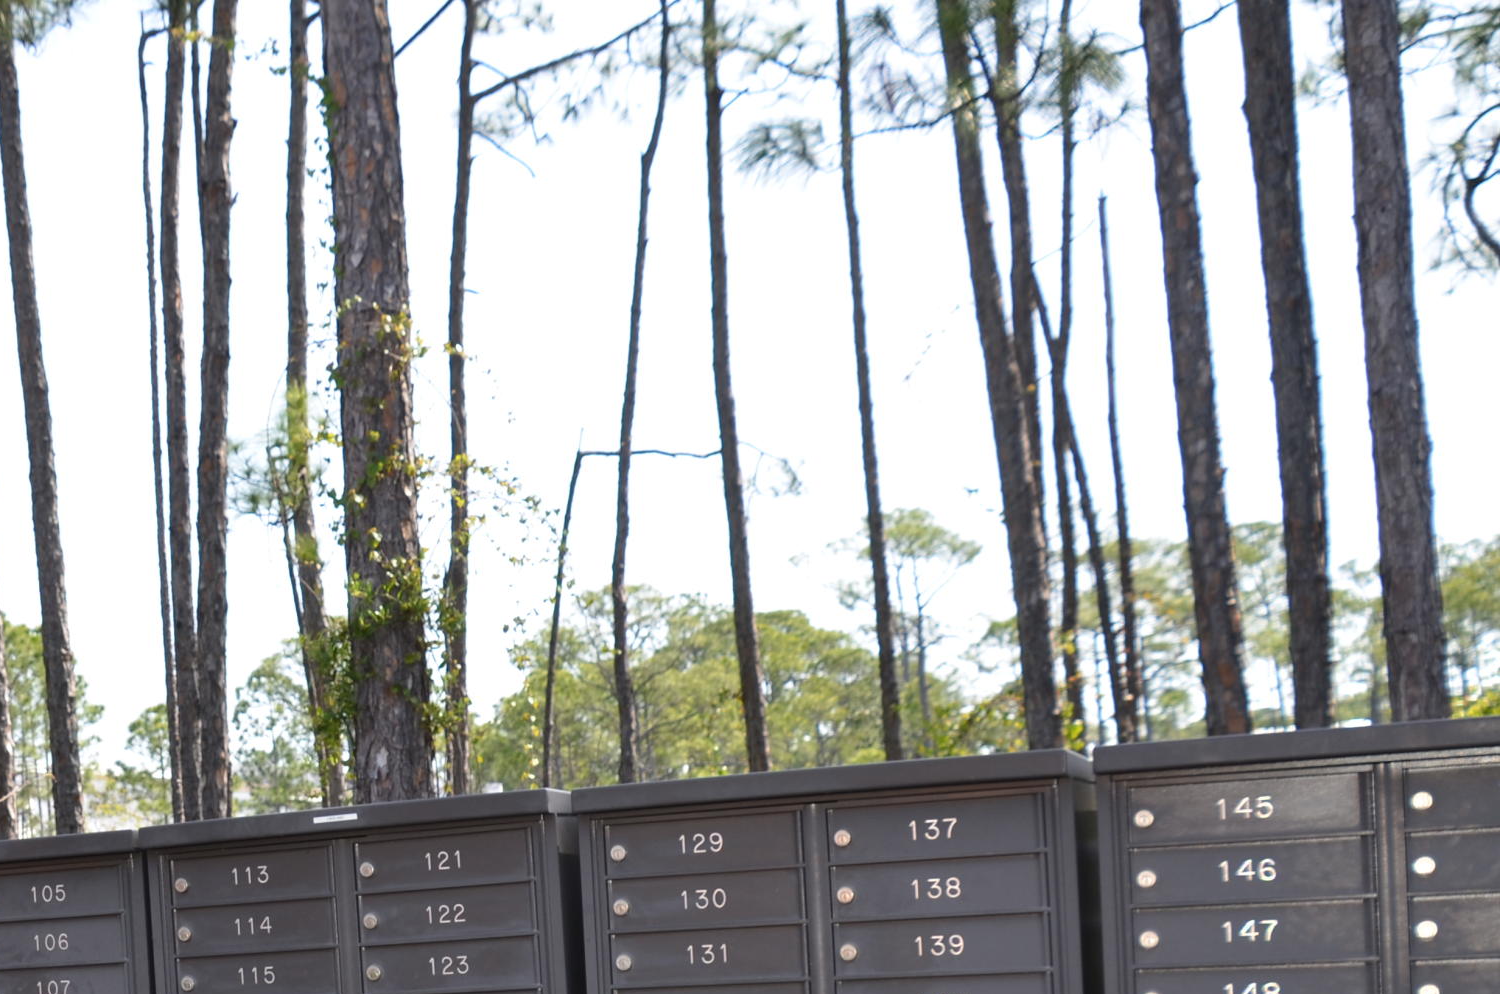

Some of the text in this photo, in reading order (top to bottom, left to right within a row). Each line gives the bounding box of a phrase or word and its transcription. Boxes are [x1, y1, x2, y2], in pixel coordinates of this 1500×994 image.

[1217, 796, 1273, 819] 145
[909, 818, 957, 840] 137
[679, 832, 723, 853] 129
[425, 850, 460, 870] 121
[1219, 858, 1276, 881] 146
[232, 865, 269, 885] 113
[31, 884, 66, 903] 105
[912, 877, 961, 899] 138
[681, 888, 726, 909] 130
[426, 904, 466, 924] 122
[235, 916, 272, 935] 114
[1223, 920, 1278, 942] 147
[34, 933, 68, 951] 106
[915, 935, 964, 956] 139
[687, 944, 727, 964] 131
[238, 966, 275, 984] 115
[429, 955, 469, 975] 123
